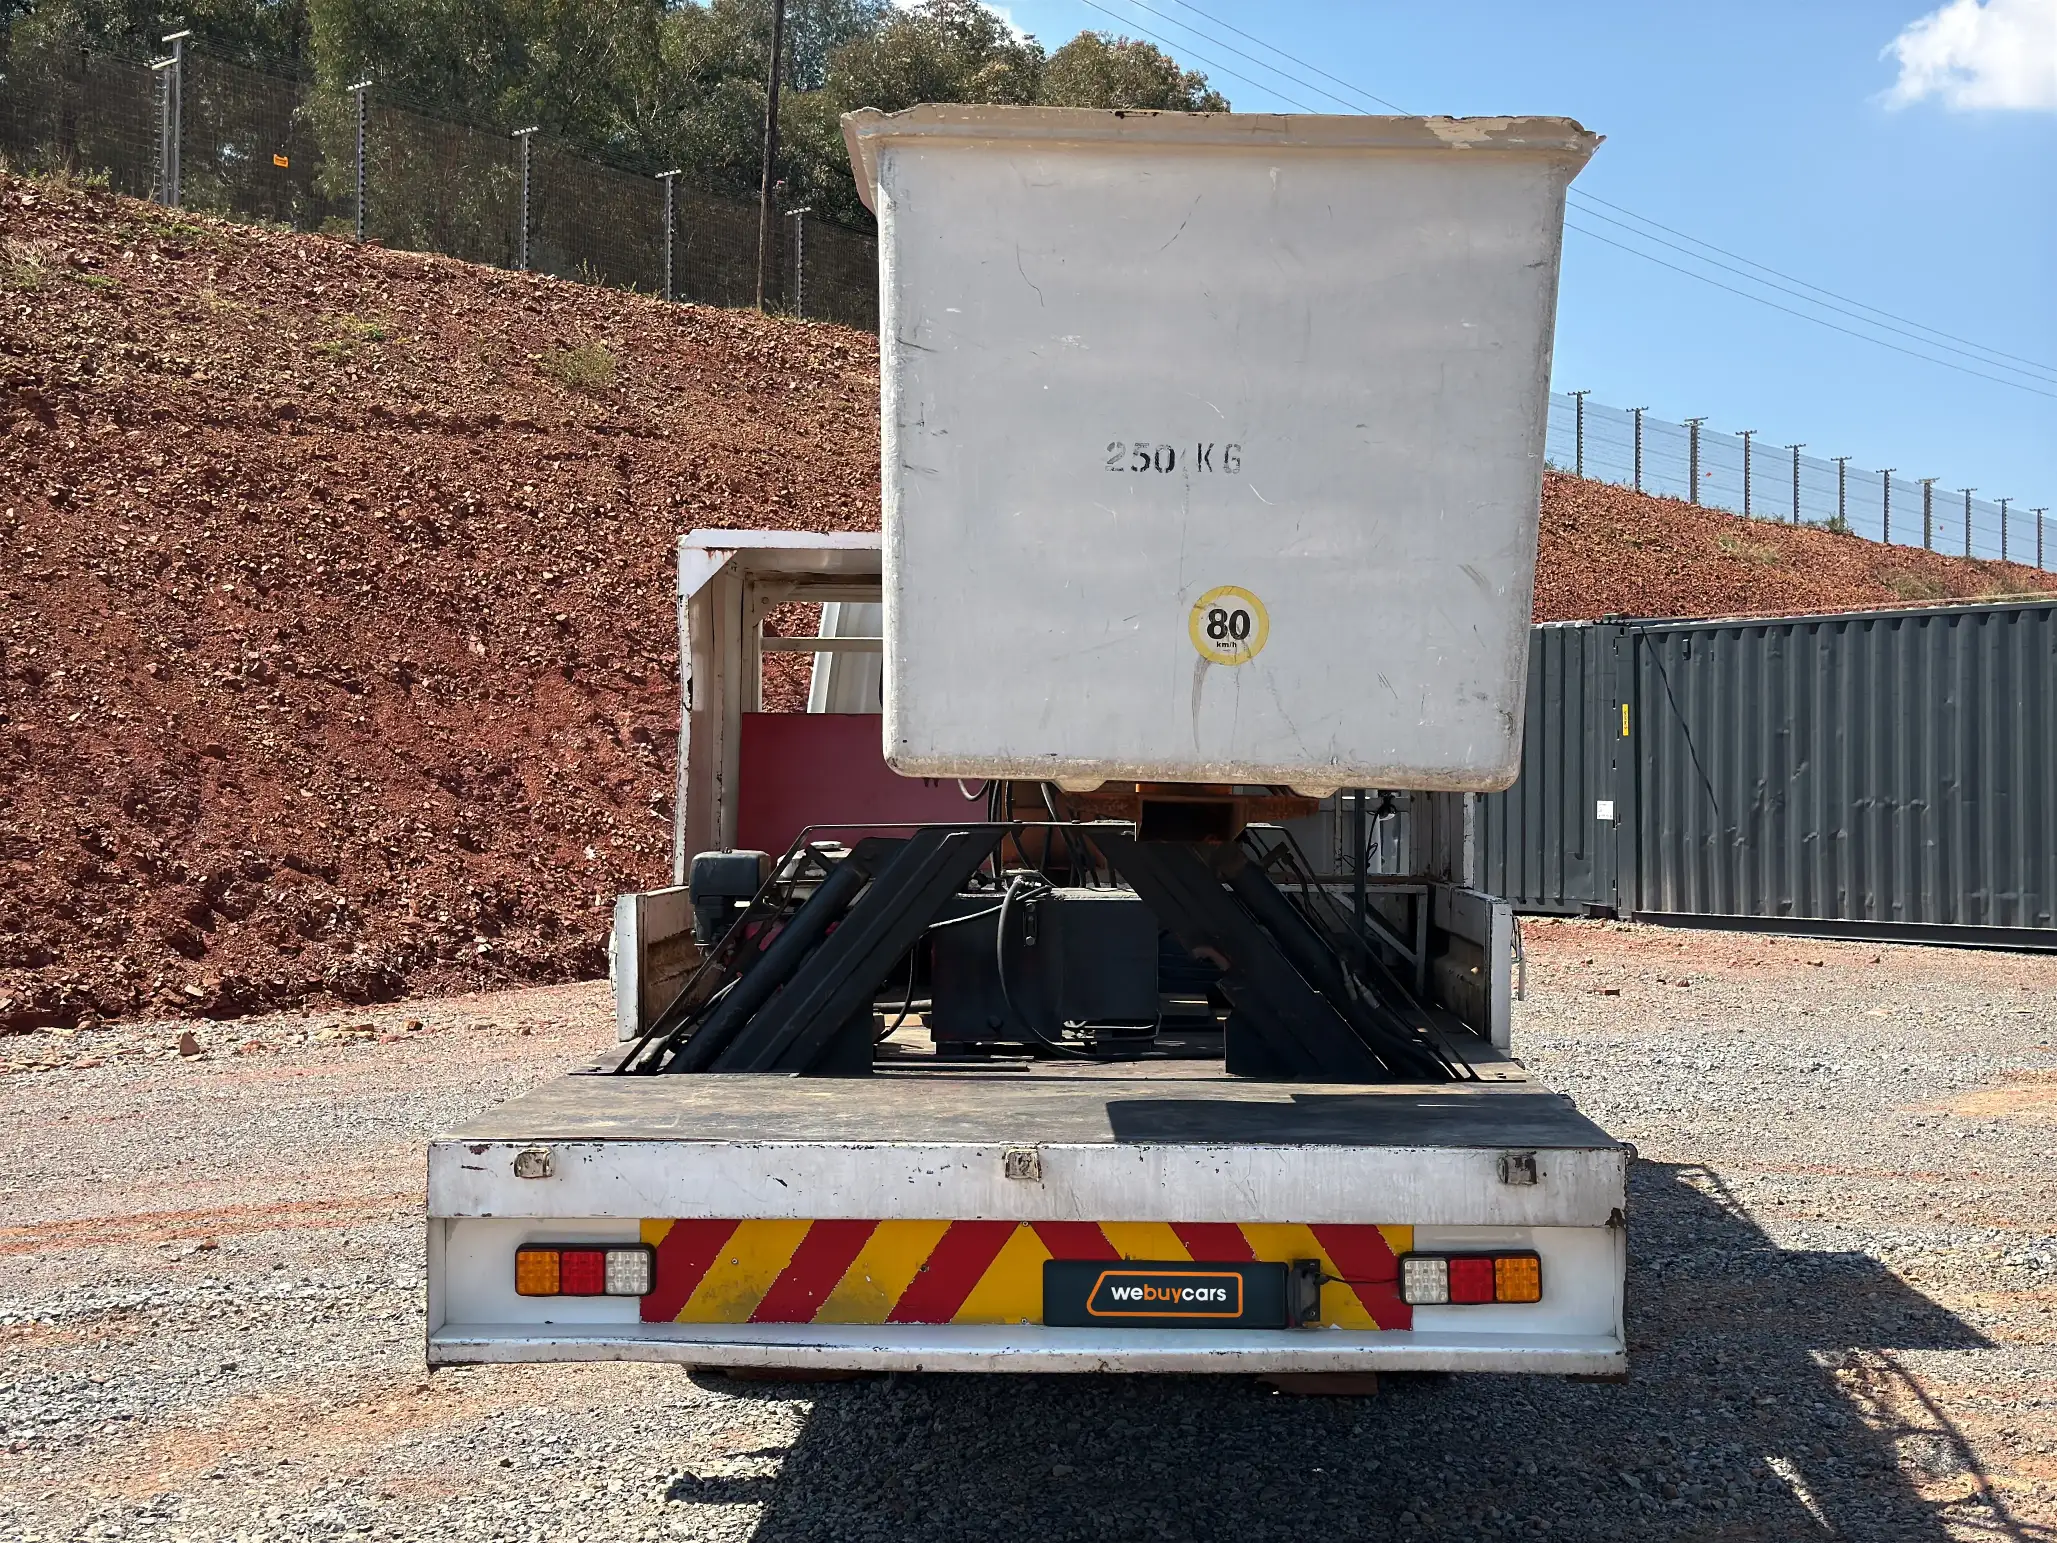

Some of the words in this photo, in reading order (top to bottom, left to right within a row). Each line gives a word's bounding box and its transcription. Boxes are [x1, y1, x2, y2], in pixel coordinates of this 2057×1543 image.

[1105, 442, 1175, 473] 250
[1197, 443, 1242, 474] KG
[1206, 608, 1250, 640] 80
[1111, 1284, 1227, 1303] webuycars
